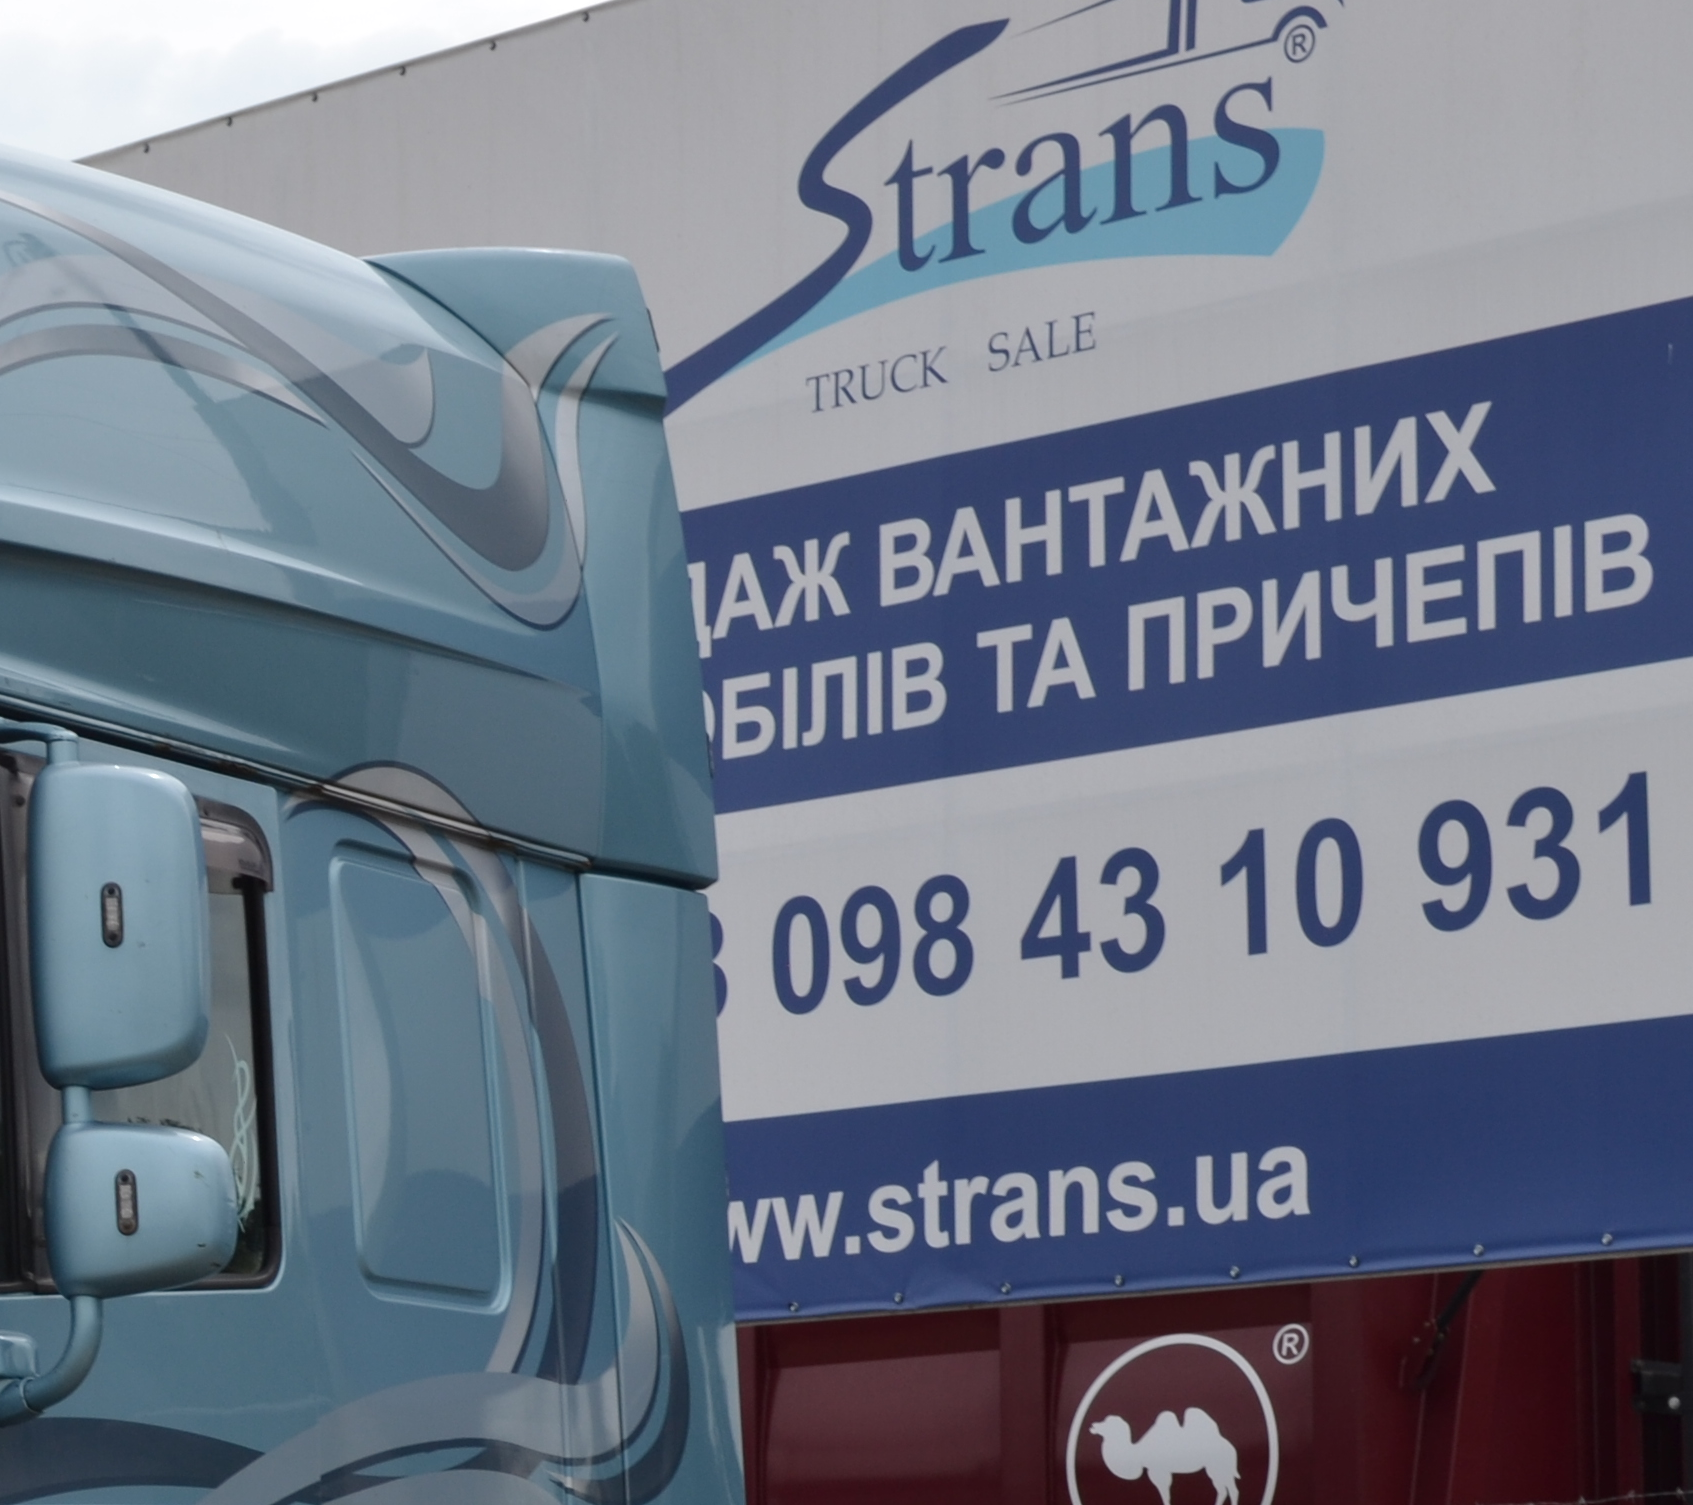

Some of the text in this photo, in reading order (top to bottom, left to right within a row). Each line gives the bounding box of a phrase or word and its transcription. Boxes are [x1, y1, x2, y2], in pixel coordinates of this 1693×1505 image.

[662, 17, 1282, 418] Strans
[806, 310, 1098, 414] TRUCK SALE
[879, 402, 1496, 607] ВАНТАЖНИХ
[702, 512, 1654, 760] БІЛІВ ТА ПРИЧЕПІВ
[770, 873, 974, 1016] 098
[1019, 846, 1166, 981] 43
[1219, 817, 1364, 957] 10
[1416, 771, 1653, 934] 931
